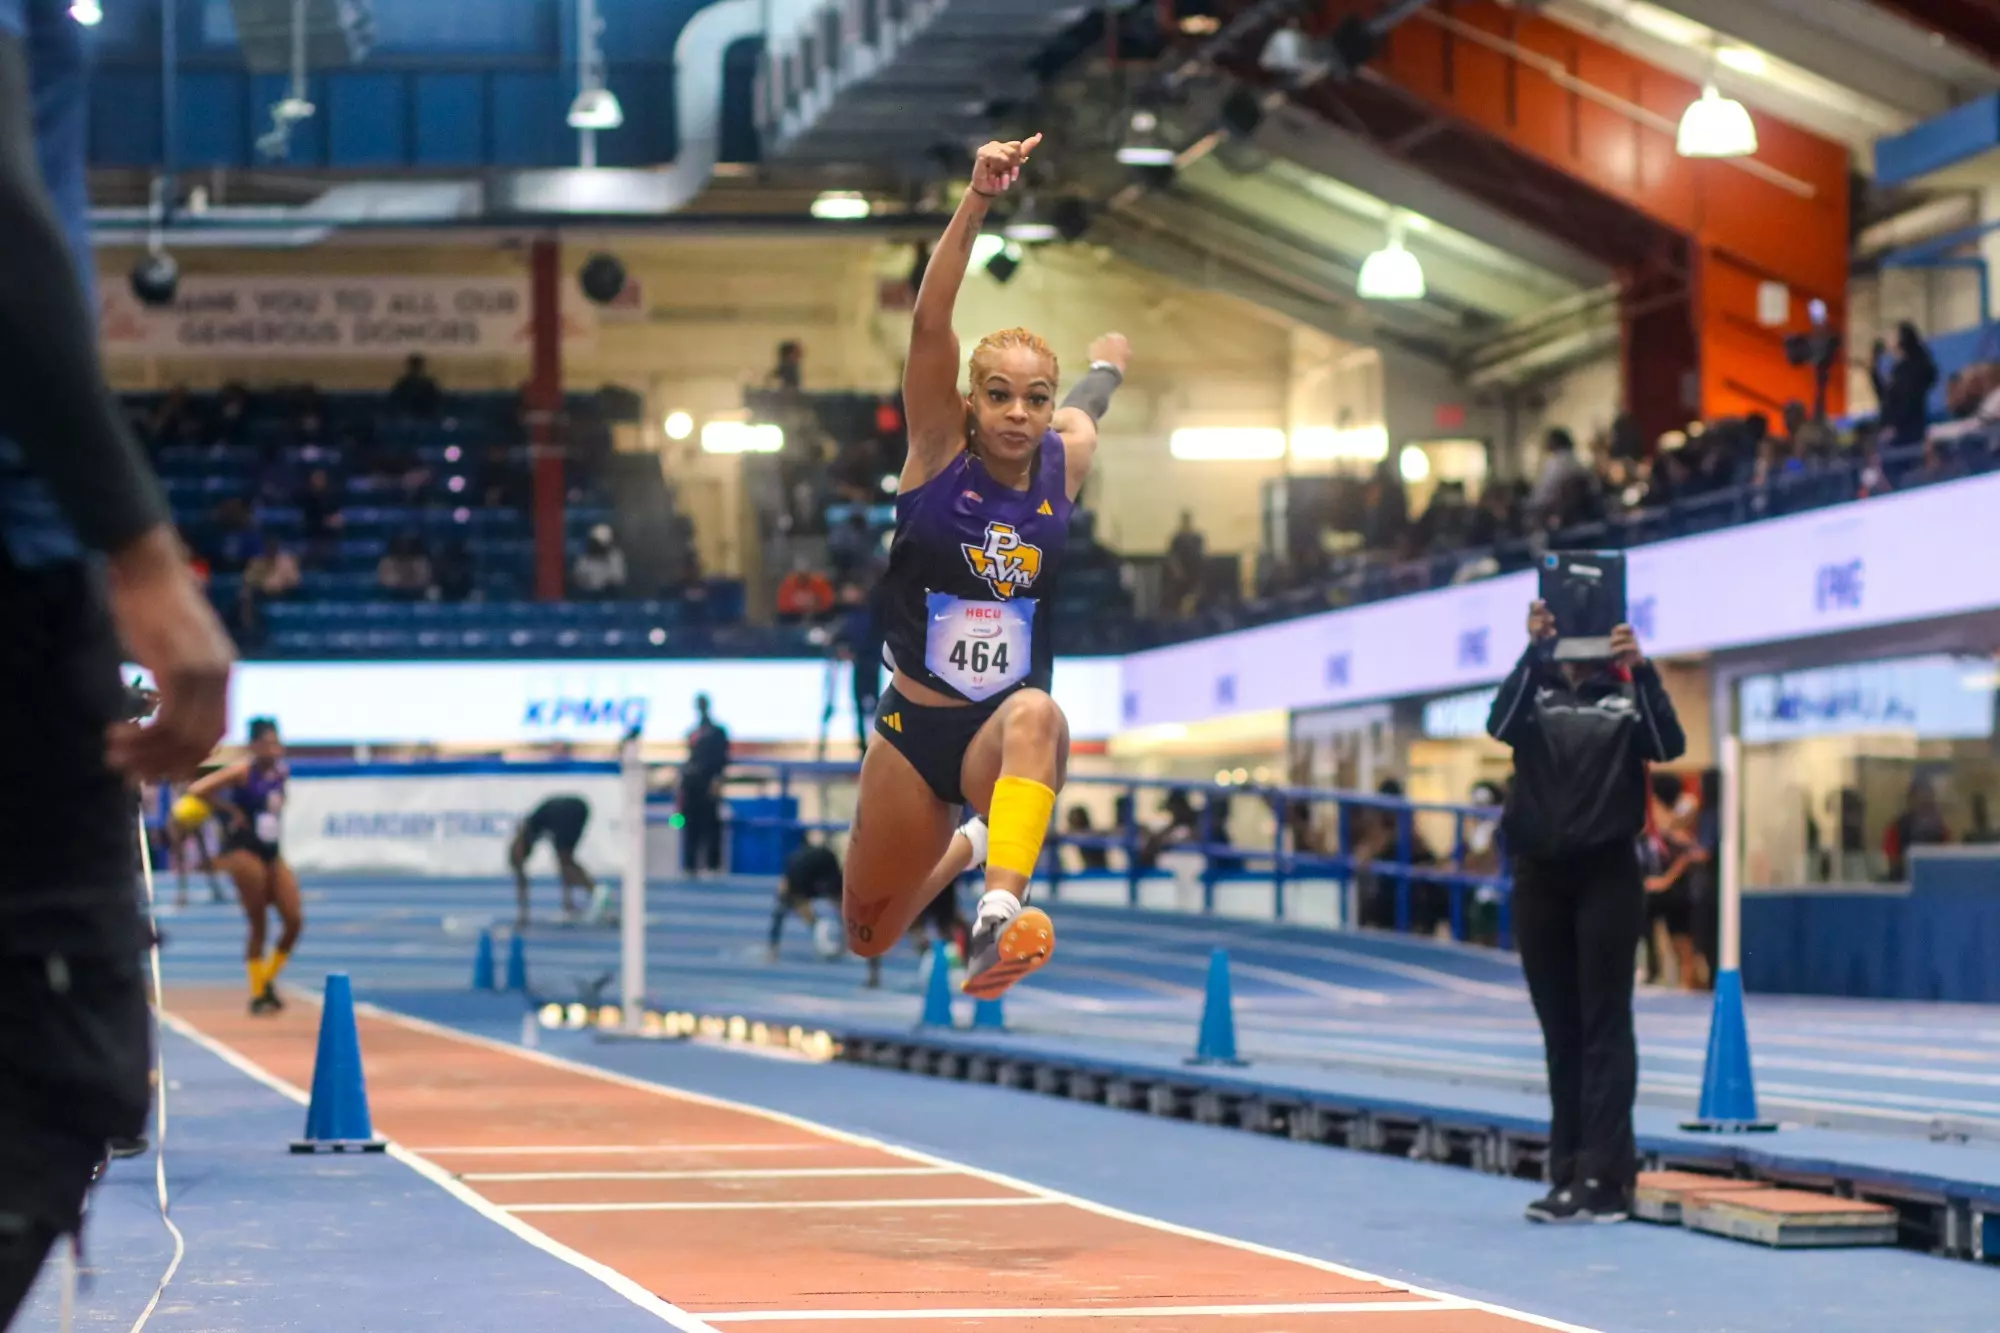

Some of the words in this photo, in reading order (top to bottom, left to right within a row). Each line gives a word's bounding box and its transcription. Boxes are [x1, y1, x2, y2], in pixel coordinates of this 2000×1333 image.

[333, 288, 375, 313] TO
[387, 291, 436, 313] ALL
[966, 607, 1002, 619] HBCU
[949, 640, 1009, 674] 464
[523, 697, 648, 727] KPMG
